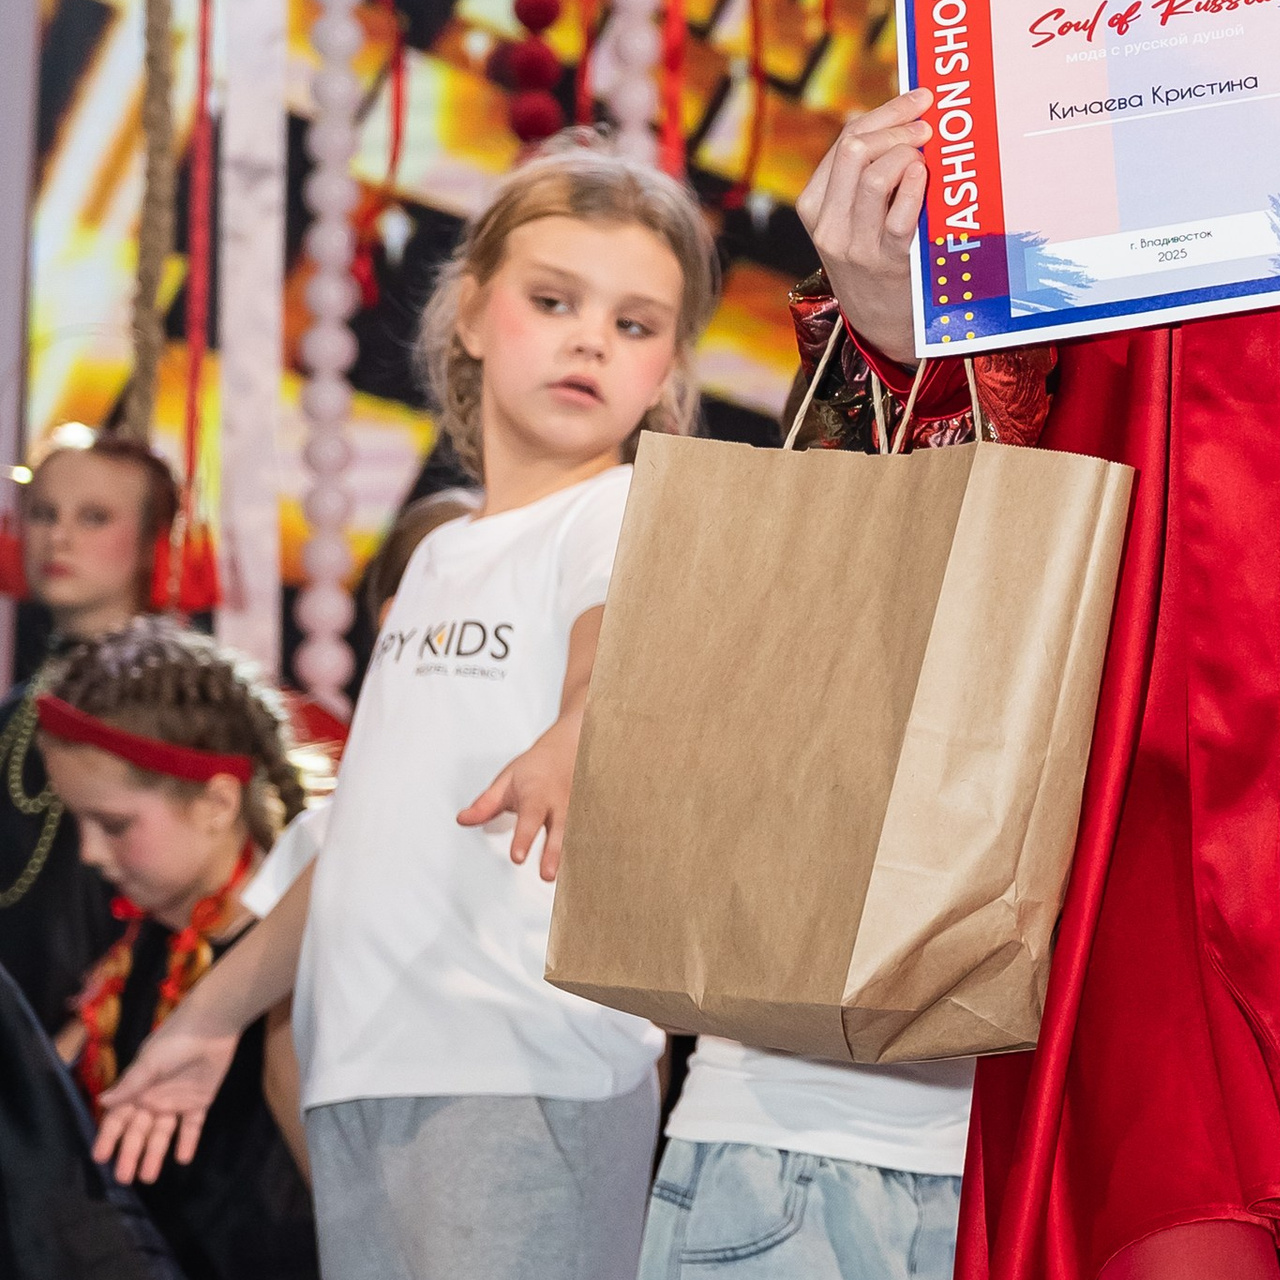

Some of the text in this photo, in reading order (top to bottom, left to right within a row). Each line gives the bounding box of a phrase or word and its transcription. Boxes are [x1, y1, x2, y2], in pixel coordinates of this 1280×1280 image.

[1028, 0, 1109, 48] Soul
[1107, 0, 1143, 36] of
[1065, 23, 1246, 64] мода с русской душой
[1049, 75, 1259, 121] Кичаева Кристина
[936, 80, 982, 254] FASHION
[1140, 230, 1214, 249] Владивосток
[1157, 248, 1189, 263] 2025
[418, 622, 514, 660] KIDS
